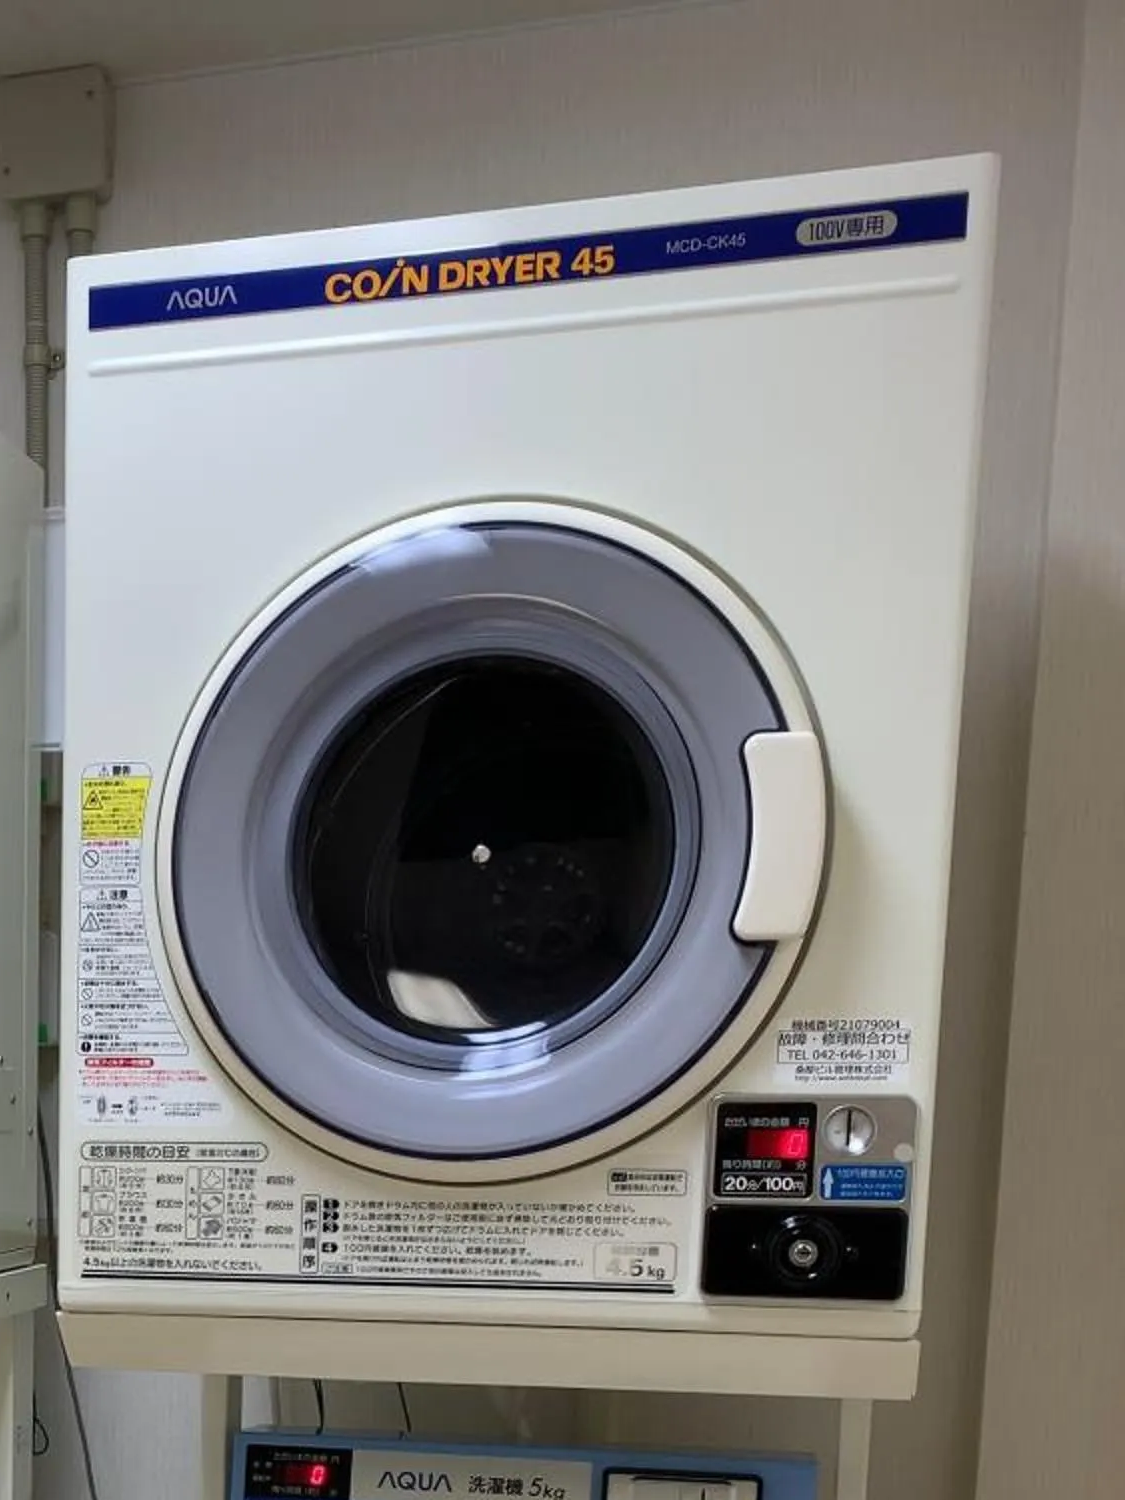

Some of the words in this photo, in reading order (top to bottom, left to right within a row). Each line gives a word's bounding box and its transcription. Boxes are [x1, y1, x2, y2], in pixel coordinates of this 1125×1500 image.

[809, 214, 885, 242] 100V専用
[666, 232, 747, 255] MCD-CK45
[325, 258, 429, 304] COIN
[438, 251, 562, 291] DRYER
[571, 244, 615, 276] 45
[167, 285, 238, 312] AQUA
[787, 1049, 810, 1061] TEL
[813, 1049, 897, 1061] 042-646-1301
[90, 1145, 191, 1159] 乾燥時間の目安
[787, 1133, 804, 1156] 0
[725, 1175, 804, 1191] 20分/100円
[309, 1464, 326, 1485] 0
[377, 1471, 453, 1493] AQUA
[468, 1475, 524, 1497] 洗濯機
